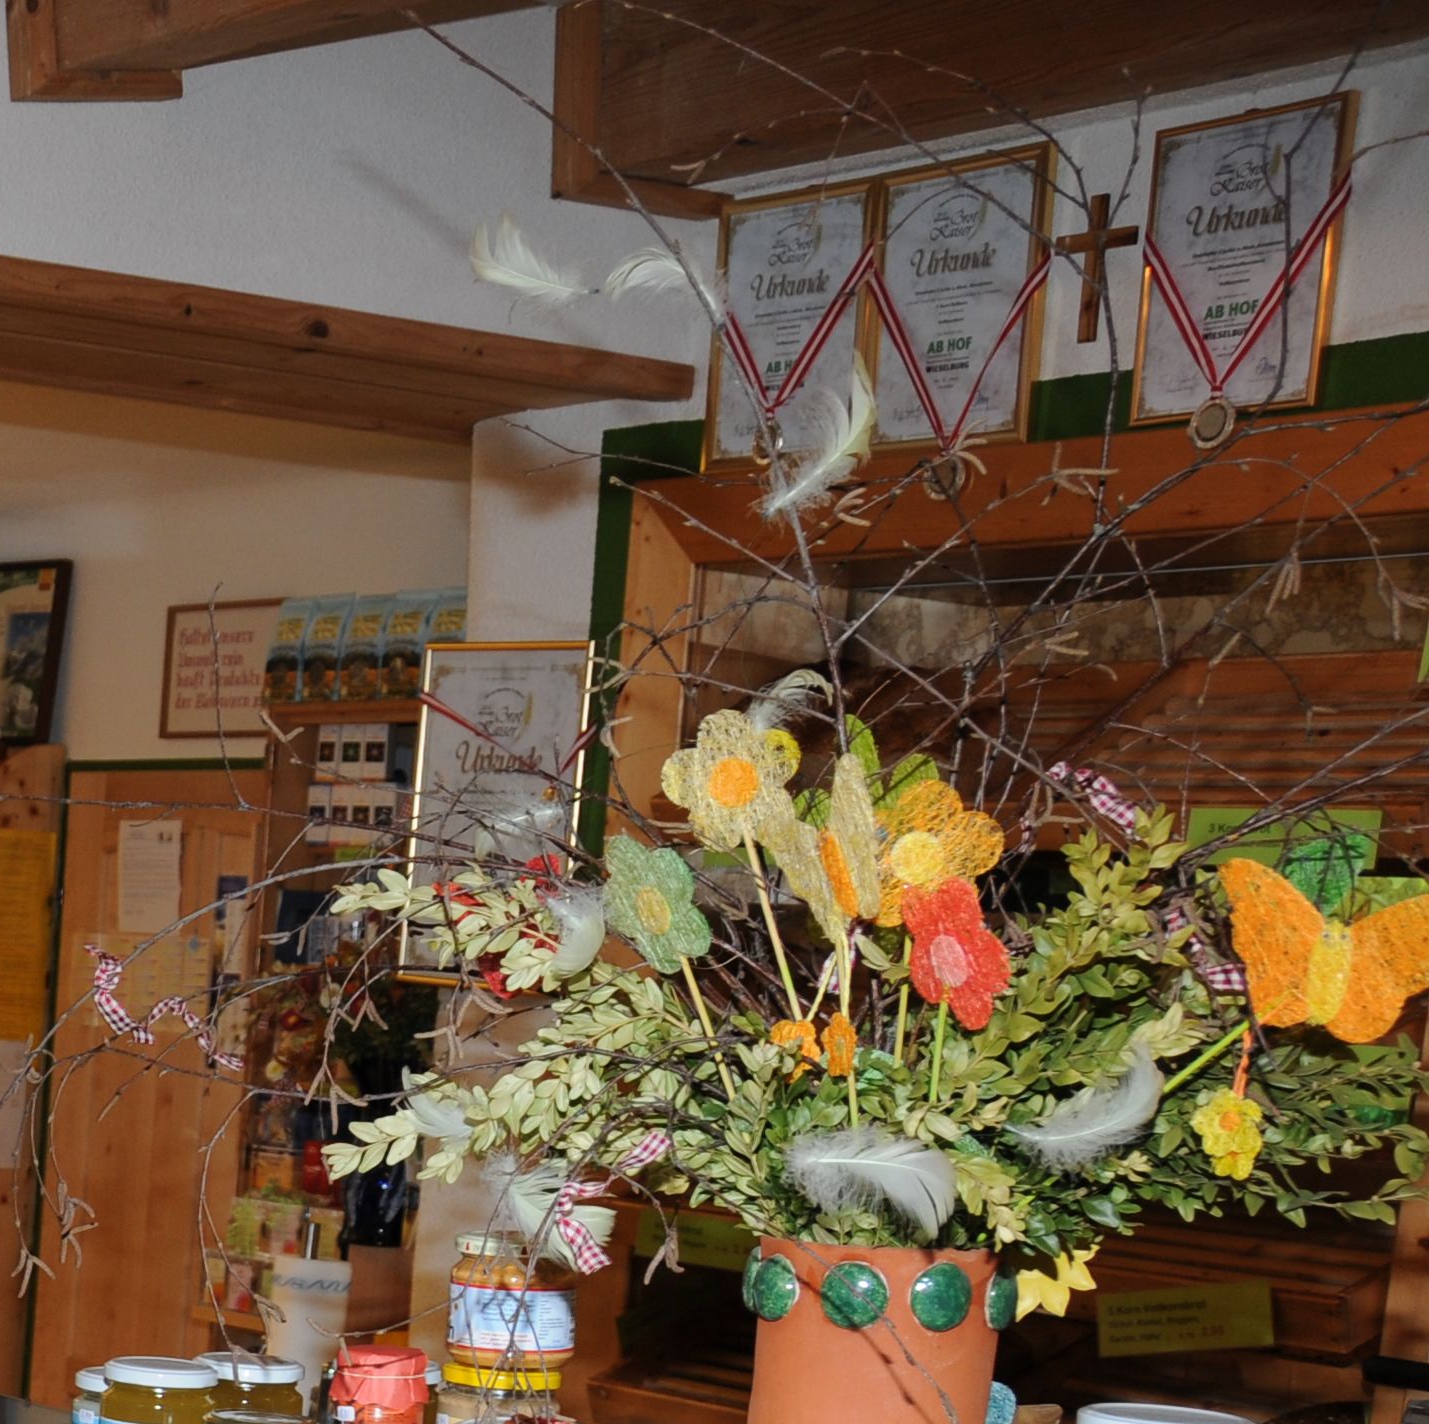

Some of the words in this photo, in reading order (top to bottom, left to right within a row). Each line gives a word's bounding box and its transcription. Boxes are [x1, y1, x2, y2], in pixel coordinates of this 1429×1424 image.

[910, 243, 996, 277] Urkunde
[750, 268, 830, 300] Urkunde
[1204, 305, 1224, 321] AB
[1228, 299, 1259, 317] HOF
[927, 340, 944, 353] AB
[947, 337, 972, 351] HOF
